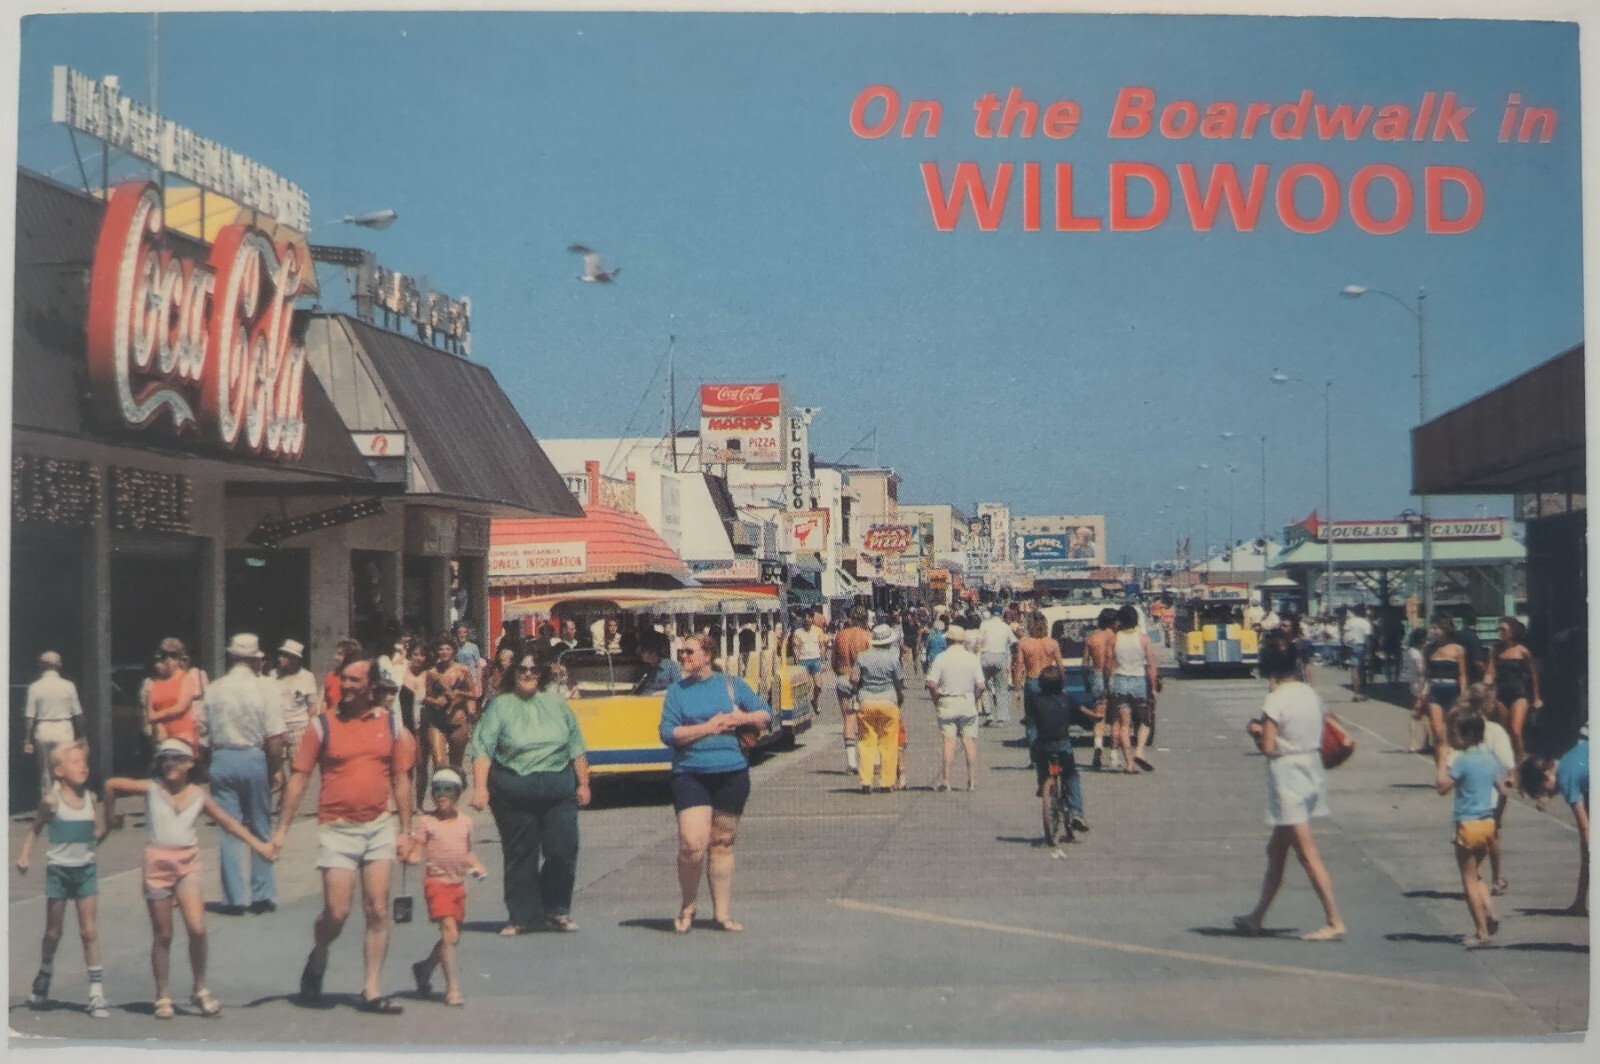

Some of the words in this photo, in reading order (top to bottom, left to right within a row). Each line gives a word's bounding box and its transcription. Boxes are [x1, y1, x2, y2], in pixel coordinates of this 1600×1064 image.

[717, 387, 741, 401] Coca
[740, 385, 763, 401] Cola
[749, 437, 776, 447] PIZZA
[1432, 524, 1497, 535] CANDIES
[526, 556, 582, 569] INFORMATION
